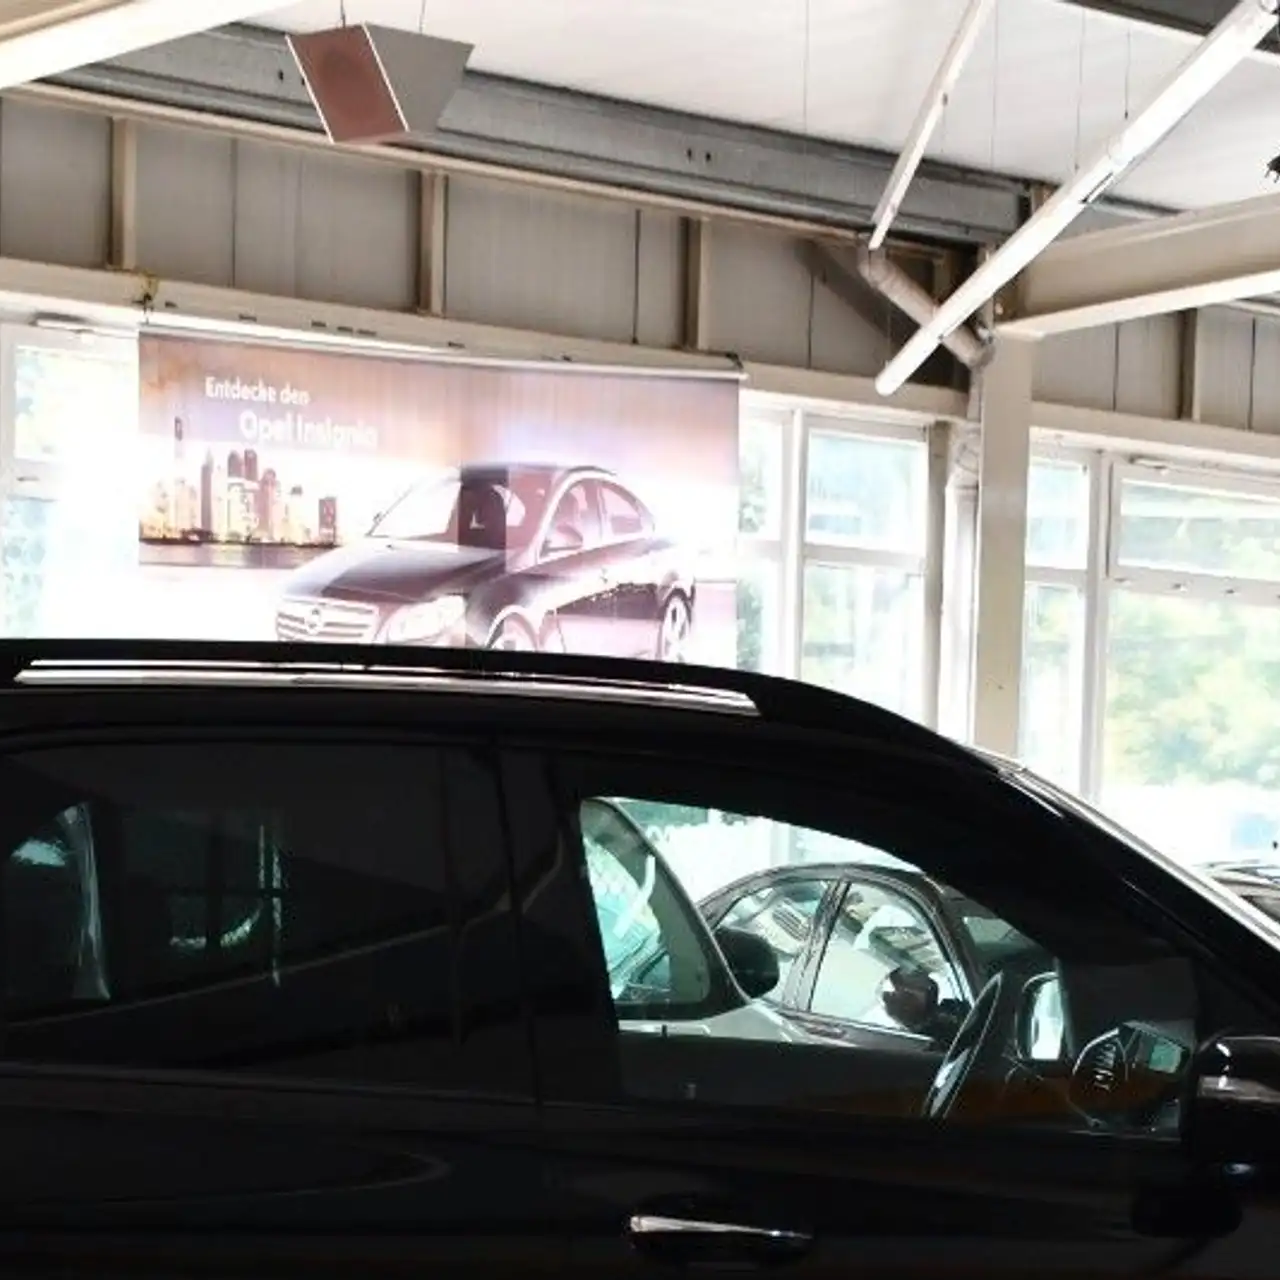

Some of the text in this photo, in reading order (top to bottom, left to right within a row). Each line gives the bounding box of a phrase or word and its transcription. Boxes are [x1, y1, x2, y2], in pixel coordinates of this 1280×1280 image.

[205, 375, 312, 406] Entdecke den
[239, 409, 293, 446] Opel
